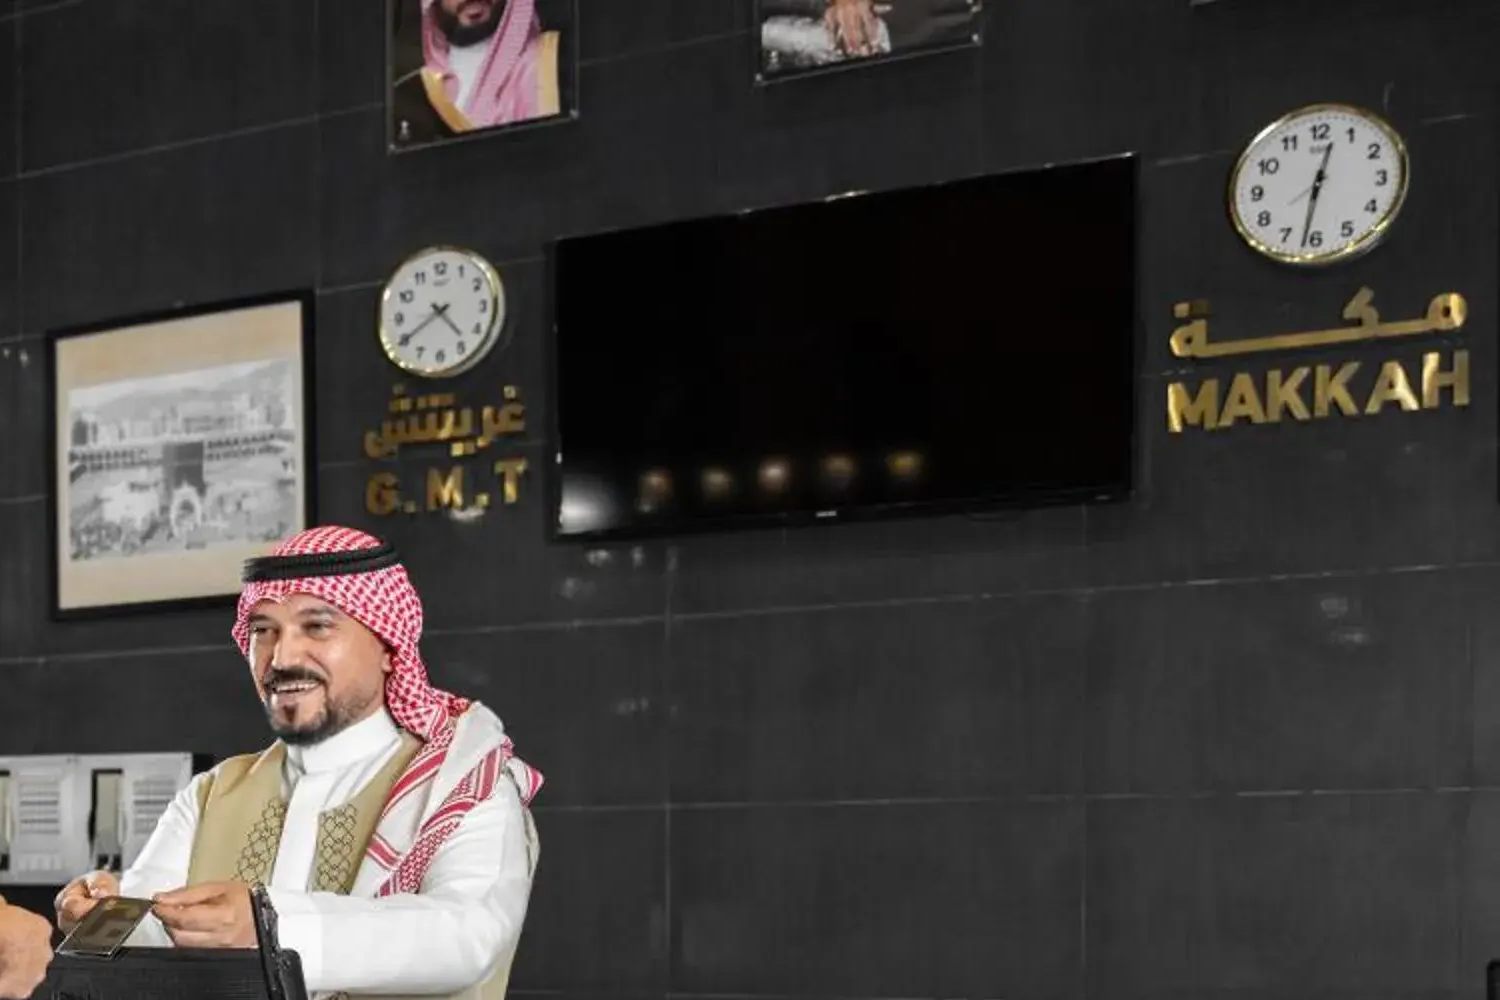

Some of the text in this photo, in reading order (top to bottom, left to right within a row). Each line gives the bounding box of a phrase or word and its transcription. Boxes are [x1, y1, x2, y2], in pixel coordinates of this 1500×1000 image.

[1309, 122, 1331, 141] 12
[1346, 127, 1355, 144] 1
[1281, 135, 1298, 151] 11
[1367, 143, 1381, 160] 2
[1258, 157, 1280, 176] 10
[1375, 169, 1388, 187] 3
[1251, 185, 1264, 202] 9
[1364, 198, 1377, 214] 4
[1257, 210, 1271, 227] 8
[1280, 227, 1292, 243] 7
[1341, 221, 1354, 238] 5
[1309, 231, 1323, 247] 6
[433, 261, 448, 276] 12
[458, 264, 464, 278] 1
[414, 271, 426, 286] 11
[472, 277, 483, 293] 2
[399, 289, 414, 304] 10
[479, 298, 487, 313] 3
[394, 311, 405, 327] 9
[1170, 286, 1467, 358] مكة
[471, 322, 481, 335] 4
[416, 346, 425, 359] 7
[435, 348, 445, 363] 6
[456, 340, 466, 355] 5
[1167, 349, 1470, 433] MAKKAH
[364, 384, 525, 458] غرينتش
